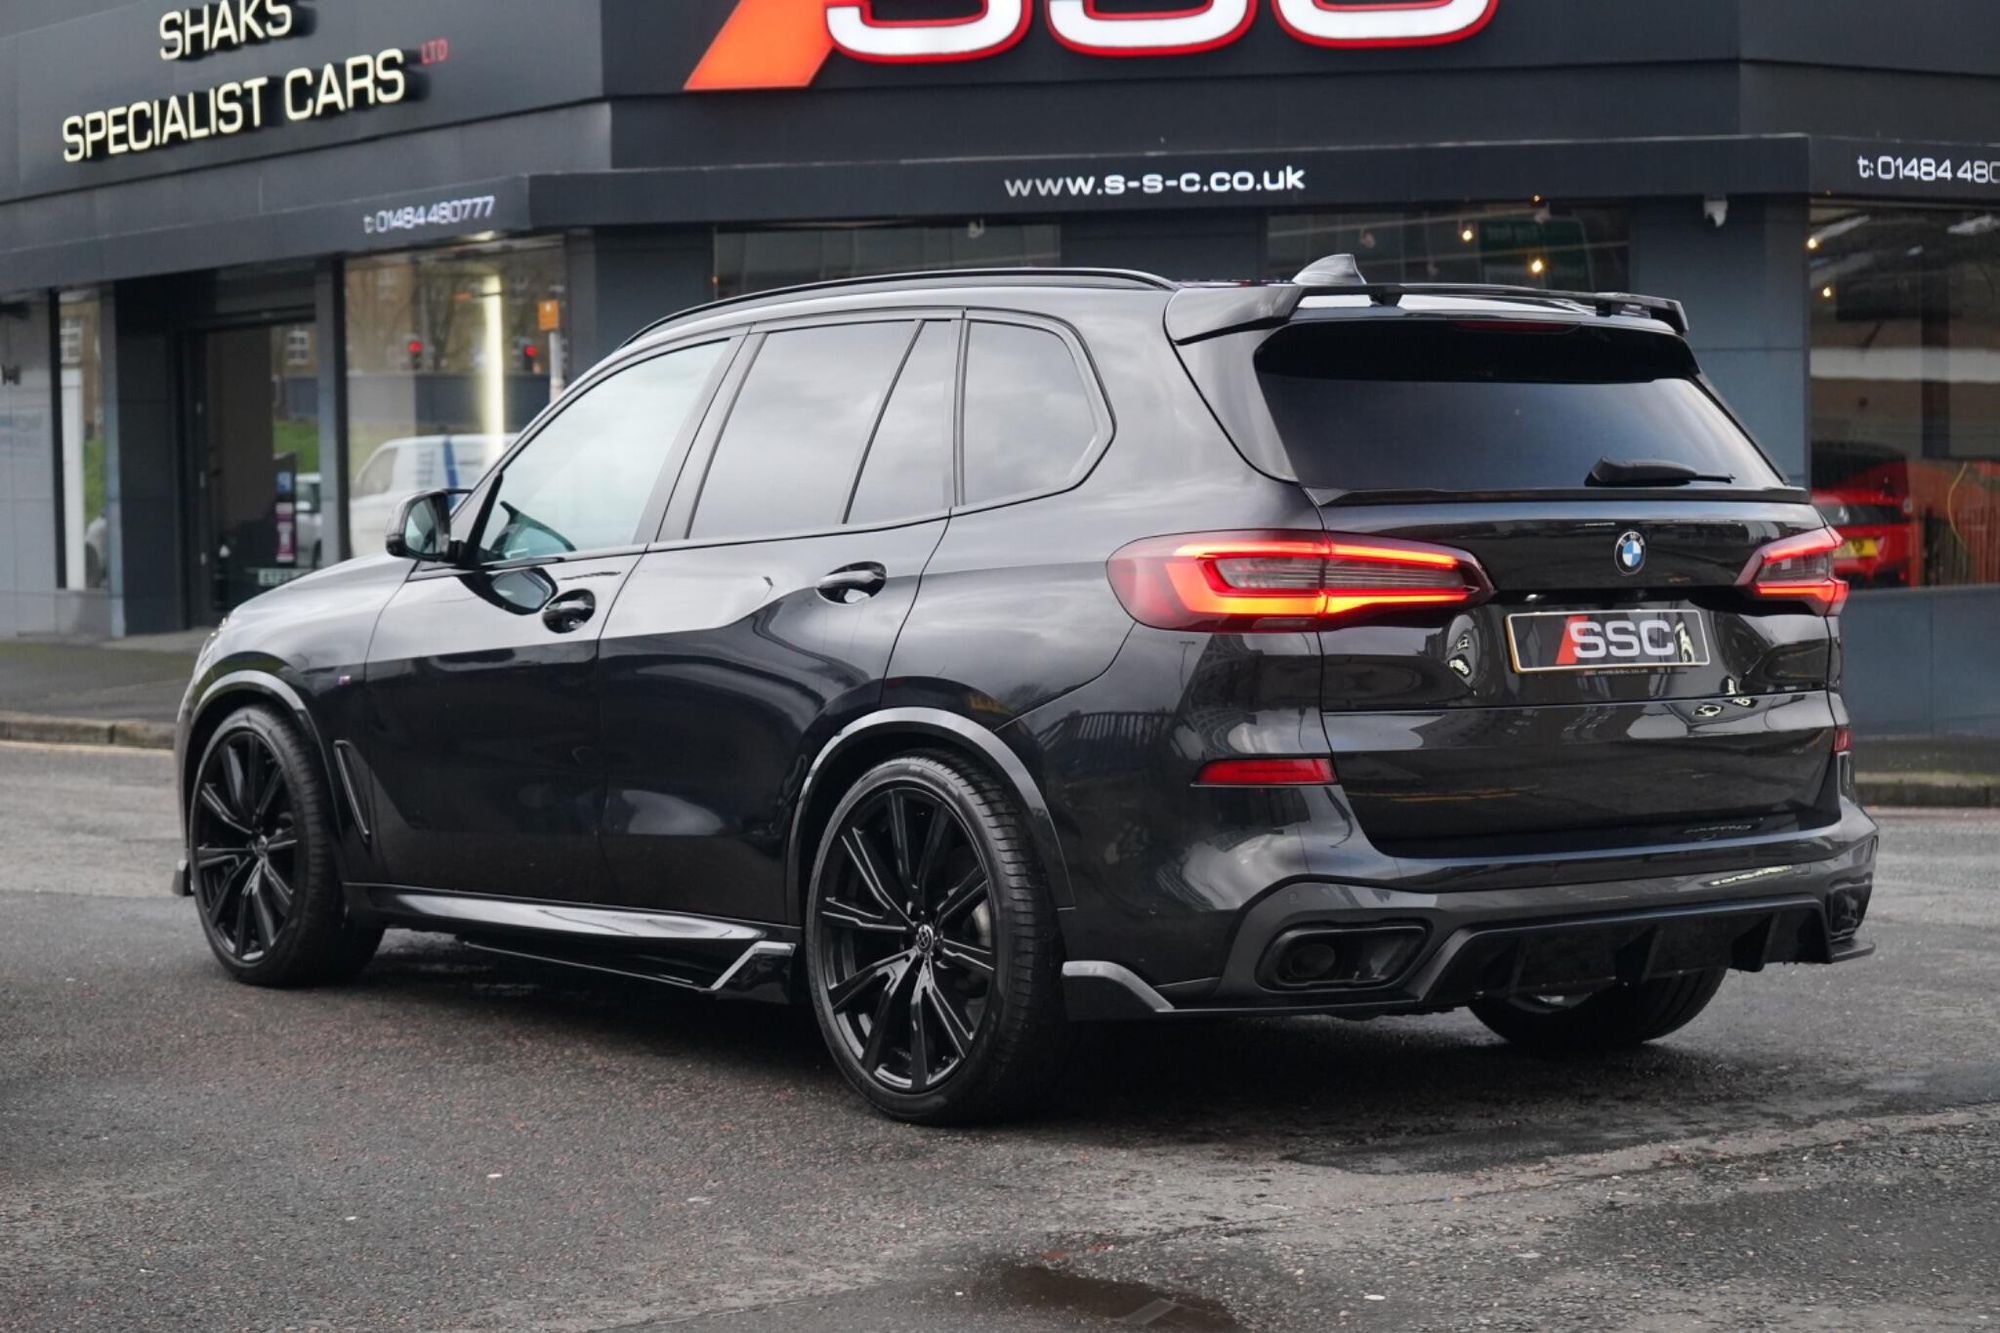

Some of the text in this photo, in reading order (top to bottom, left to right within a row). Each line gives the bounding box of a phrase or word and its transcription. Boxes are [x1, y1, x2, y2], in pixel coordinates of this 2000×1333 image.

[159, 0, 293, 60] SHAKS
[62, 38, 450, 162] SPECIALIST CARS LTD
[1004, 166, 1306, 197] www.s-s-c.co.uk
[1877, 155, 1953, 181] 01484
[1569, 619, 1676, 659] SSC
